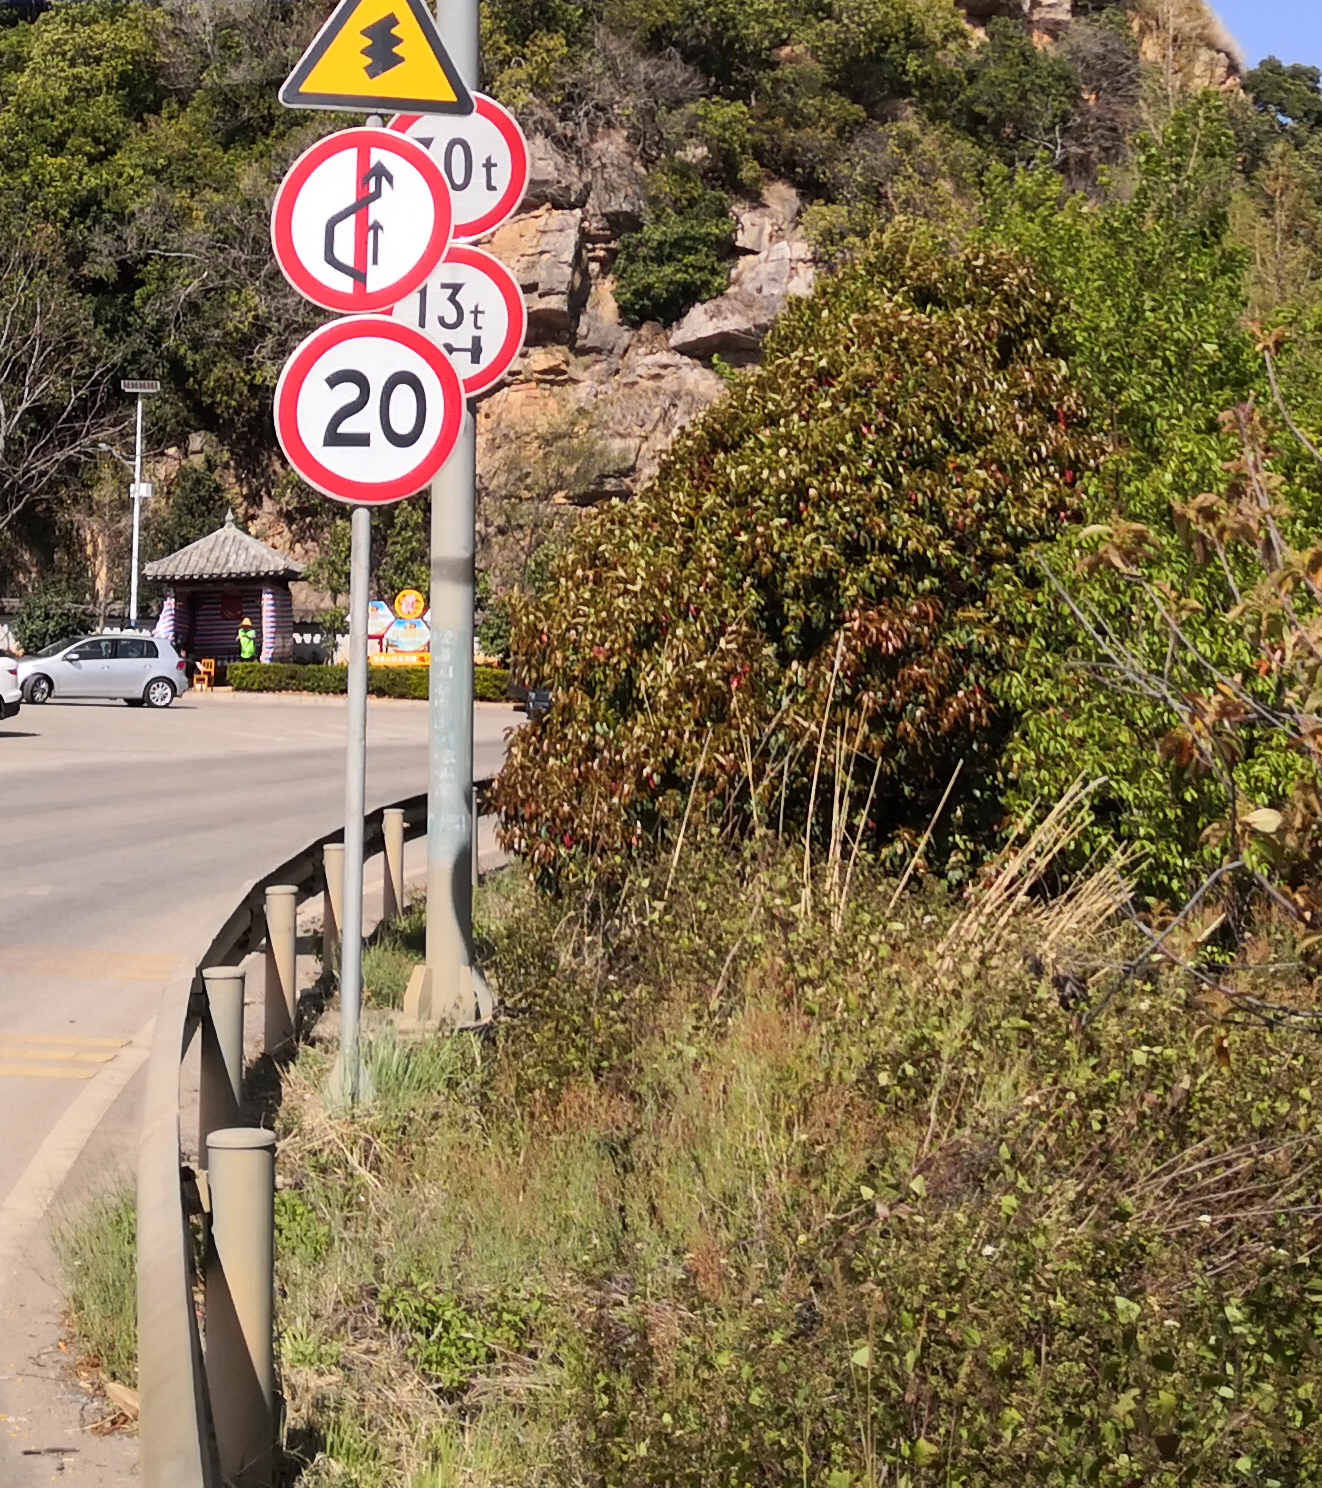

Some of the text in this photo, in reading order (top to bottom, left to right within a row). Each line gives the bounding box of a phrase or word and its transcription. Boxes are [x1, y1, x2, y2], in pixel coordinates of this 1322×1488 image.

[413, 137, 498, 192] 0t
[417, 282, 485, 330] 13t
[322, 368, 427, 448] 20
